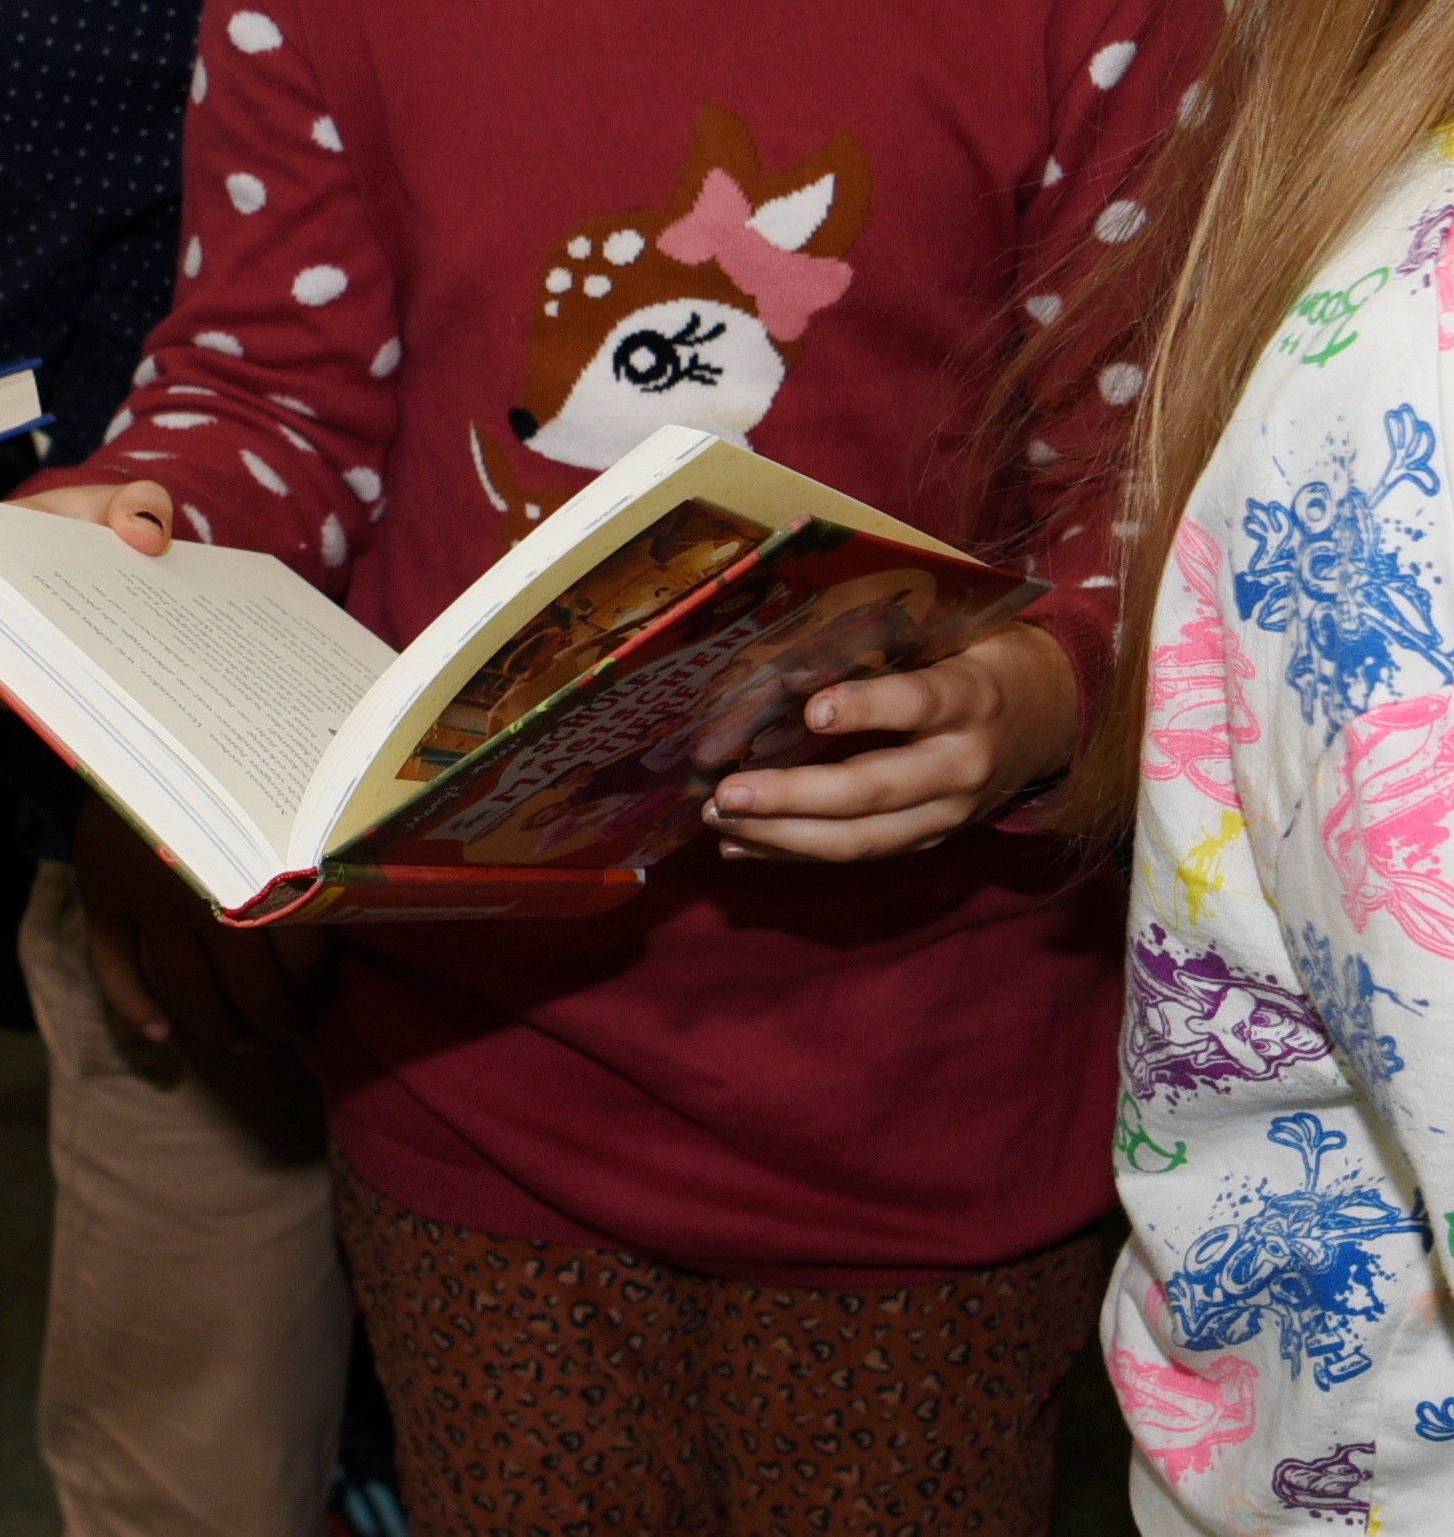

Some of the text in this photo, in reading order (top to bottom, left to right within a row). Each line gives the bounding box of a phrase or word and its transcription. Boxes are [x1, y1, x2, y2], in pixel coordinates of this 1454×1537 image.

[490, 627, 755, 803] MAGISCHEN
[533, 672, 657, 762] SCHULE
[595, 685, 700, 755] TIERE
[246, 759, 300, 812] eklungen
